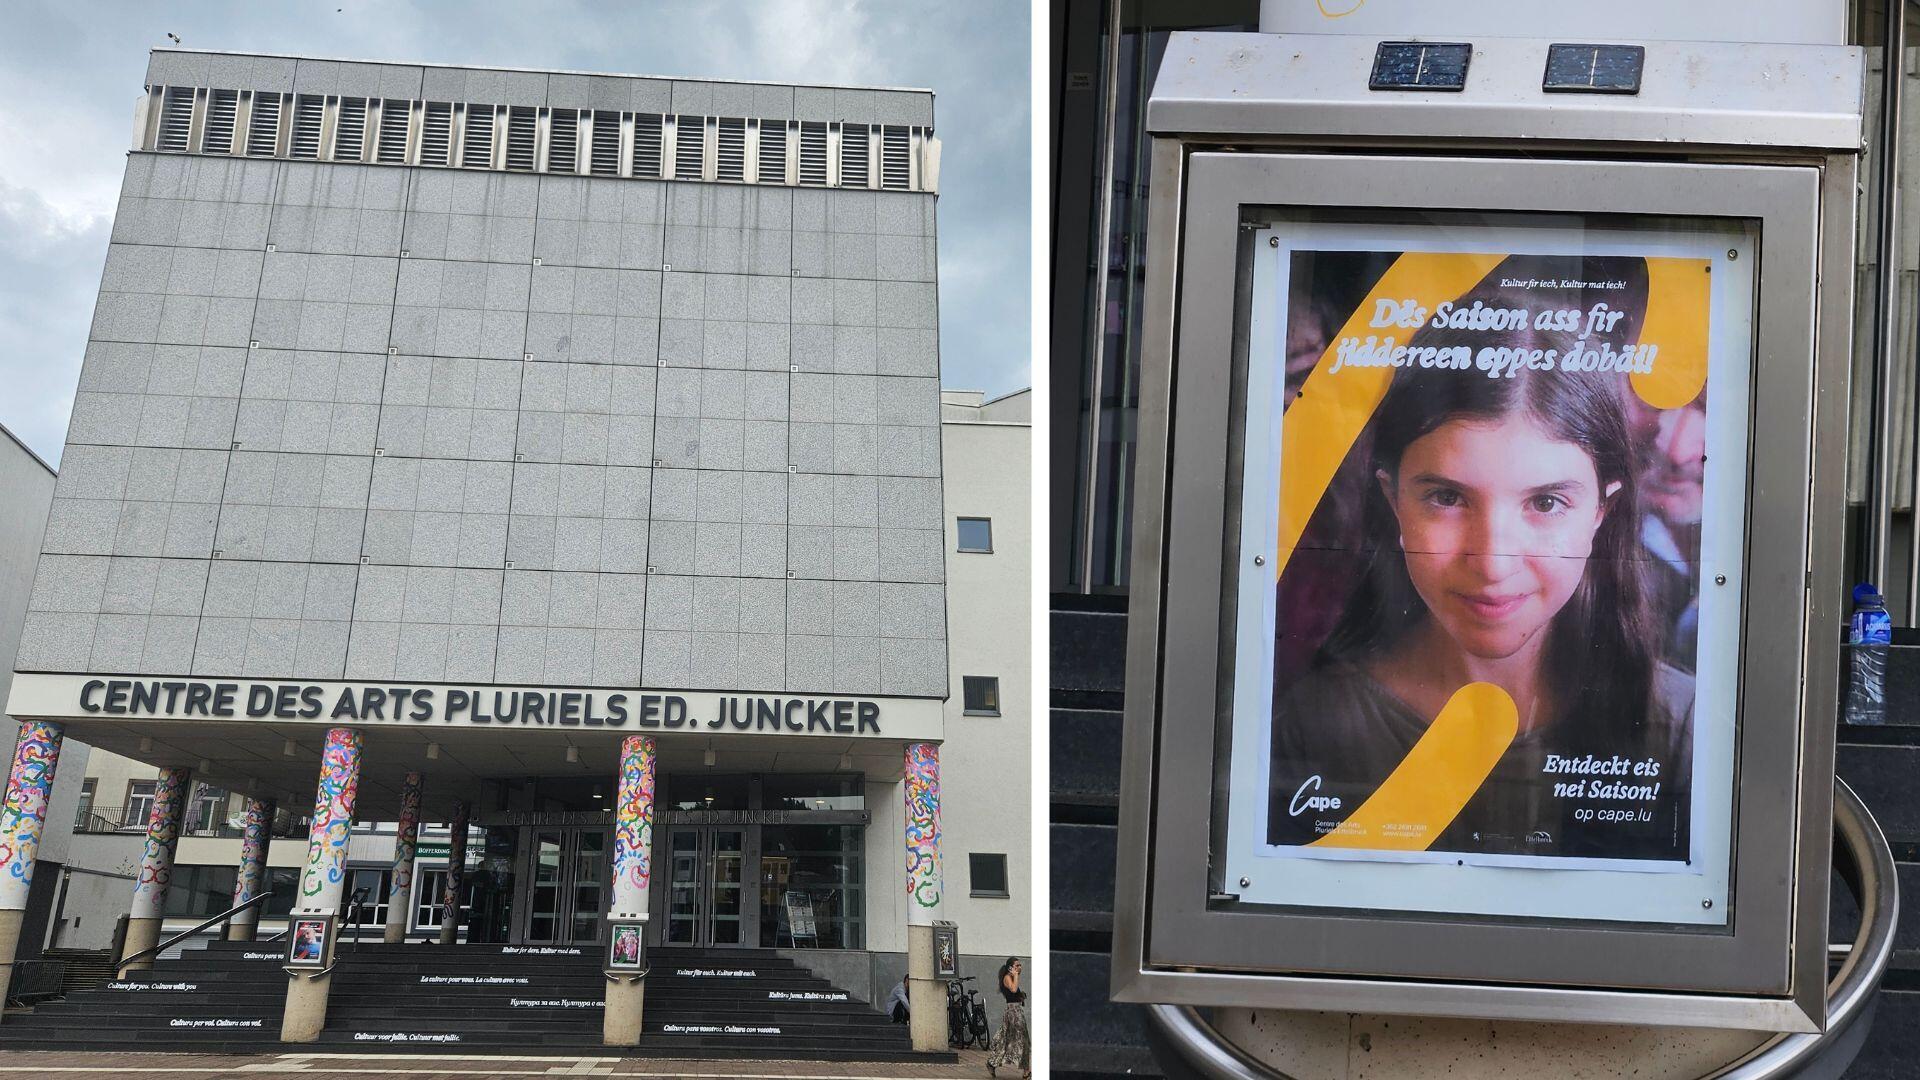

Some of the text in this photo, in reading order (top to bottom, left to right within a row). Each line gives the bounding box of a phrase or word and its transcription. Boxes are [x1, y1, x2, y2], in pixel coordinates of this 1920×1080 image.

[1500, 278, 1627, 290] Kultur fir iech, Kultur mat iech!
[1368, 298, 1625, 340] Dës Saison ass fir
[1328, 335, 1658, 379] jiddereen eppes dobäi!
[79, 679, 882, 733] CENTRE DES ARTS PLURIELS ED. JUNCKER
[1542, 754, 1660, 776] Entdeckt eis
[1288, 775, 1341, 816] Cape
[1553, 779, 1660, 800] nei Saison!
[728, 809, 789, 825] JUNCKER
[1574, 807, 1652, 823] op cape.lu
[192, 1020, 205, 1028] per
[354, 1032, 378, 1040] Cultuur
[409, 1033, 433, 1041] Cultuur
